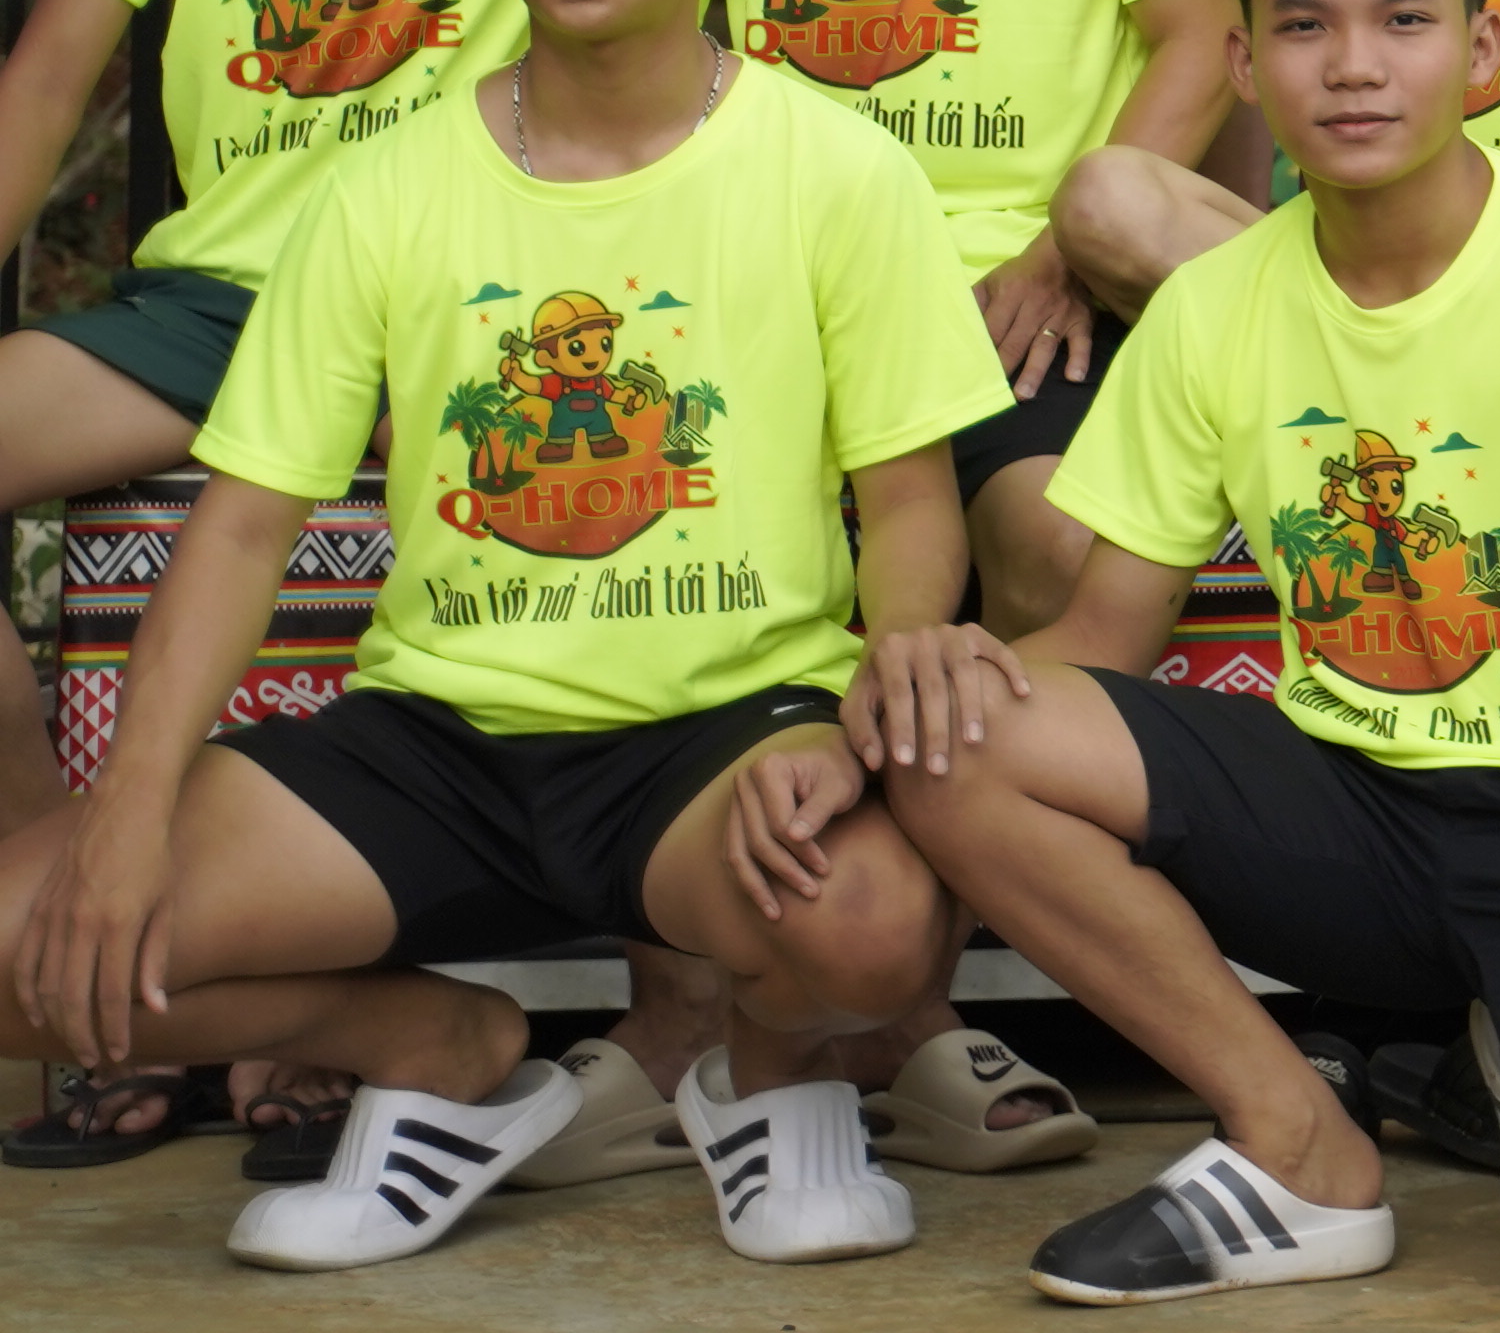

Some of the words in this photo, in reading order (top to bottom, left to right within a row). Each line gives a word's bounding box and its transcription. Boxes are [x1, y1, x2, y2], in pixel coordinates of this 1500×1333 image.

[338, 97, 400, 143] Chơi
[926, 101, 963, 148] tới
[973, 96, 1024, 149] bến
[437, 467, 719, 540] Q-HOME
[423, 577, 481, 627] Làm
[487, 576, 528, 624] tới
[532, 572, 579, 622] nơi
[591, 566, 653, 619] Chơi
[664, 562, 706, 615] tới
[717, 551, 767, 612] bến
